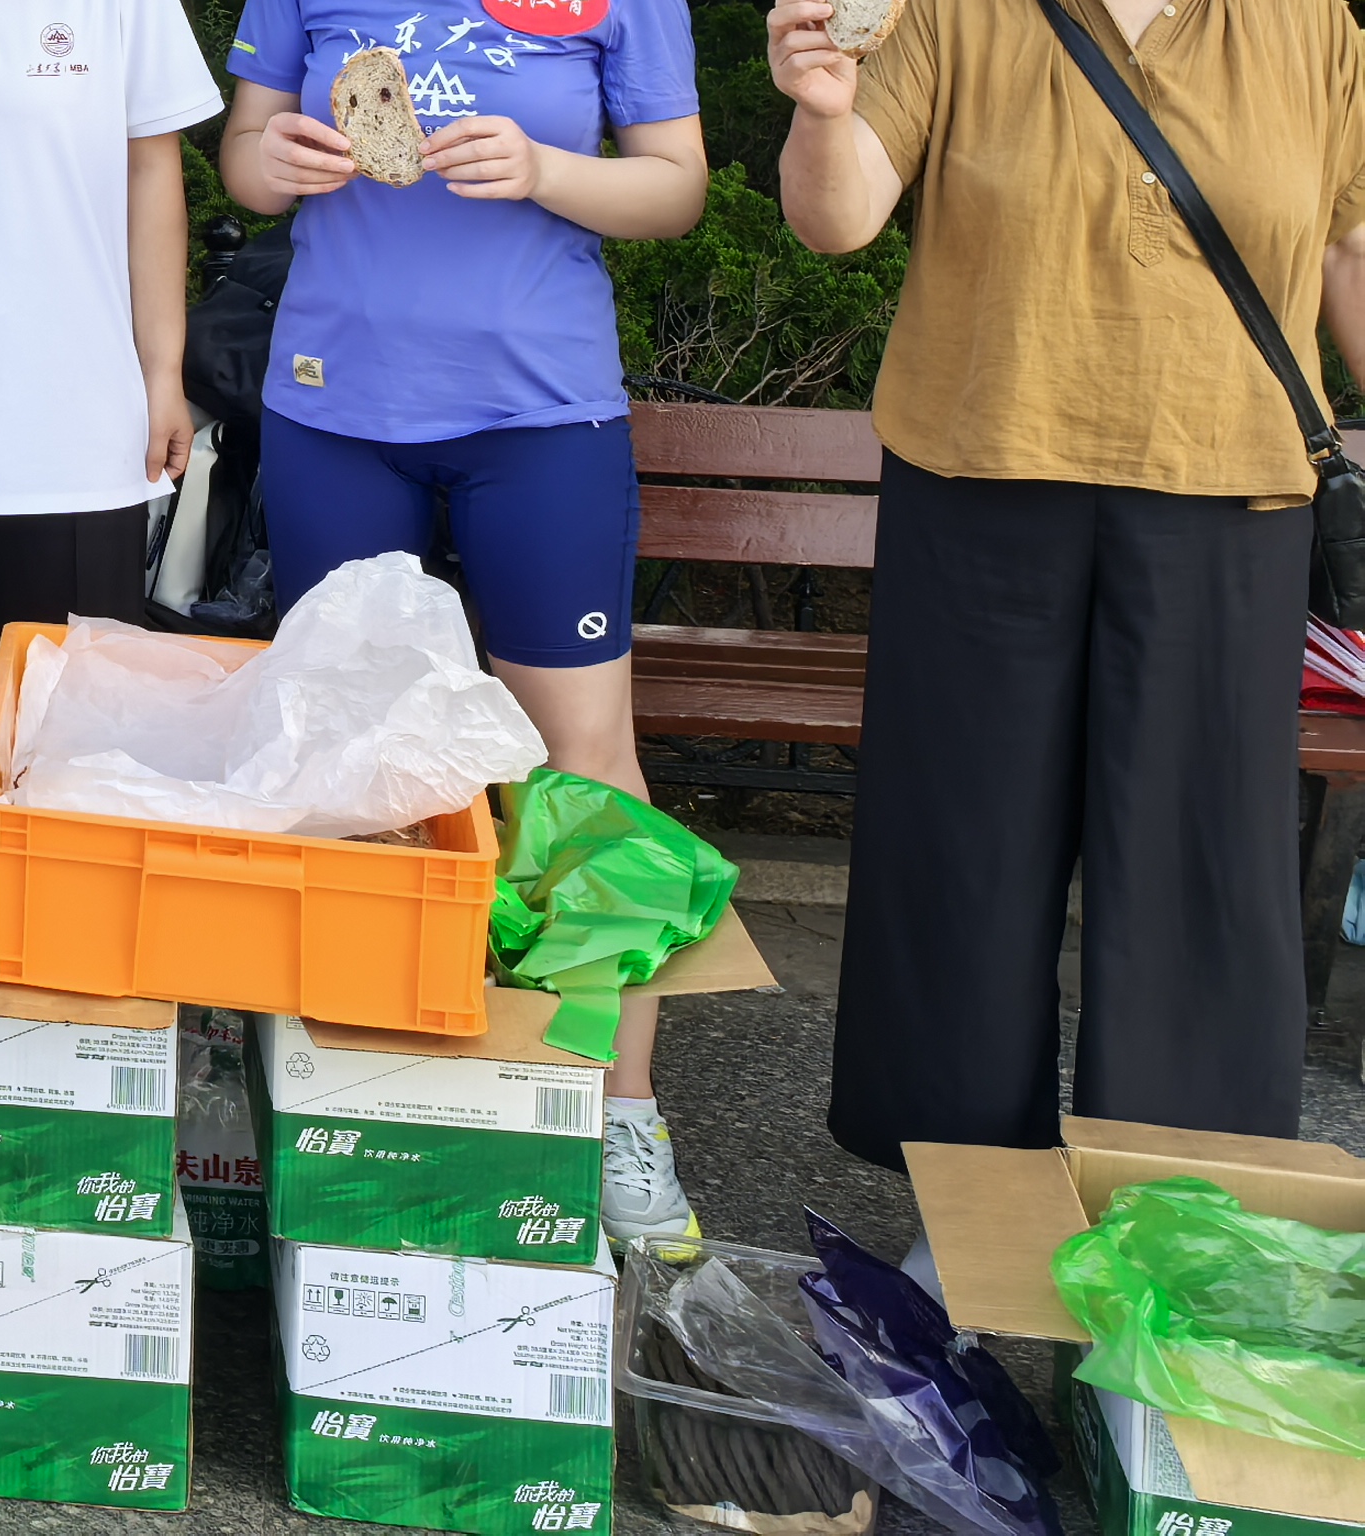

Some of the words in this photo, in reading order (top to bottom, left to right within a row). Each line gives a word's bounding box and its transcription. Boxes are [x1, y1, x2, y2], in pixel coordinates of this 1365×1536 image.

[76, 1171, 136, 1195] 你我的
[228, 1197, 260, 1208] WATER
[498, 1195, 560, 1218] 你我的
[90, 1441, 149, 1464] 你我的
[513, 1480, 576, 1503] 你我的
